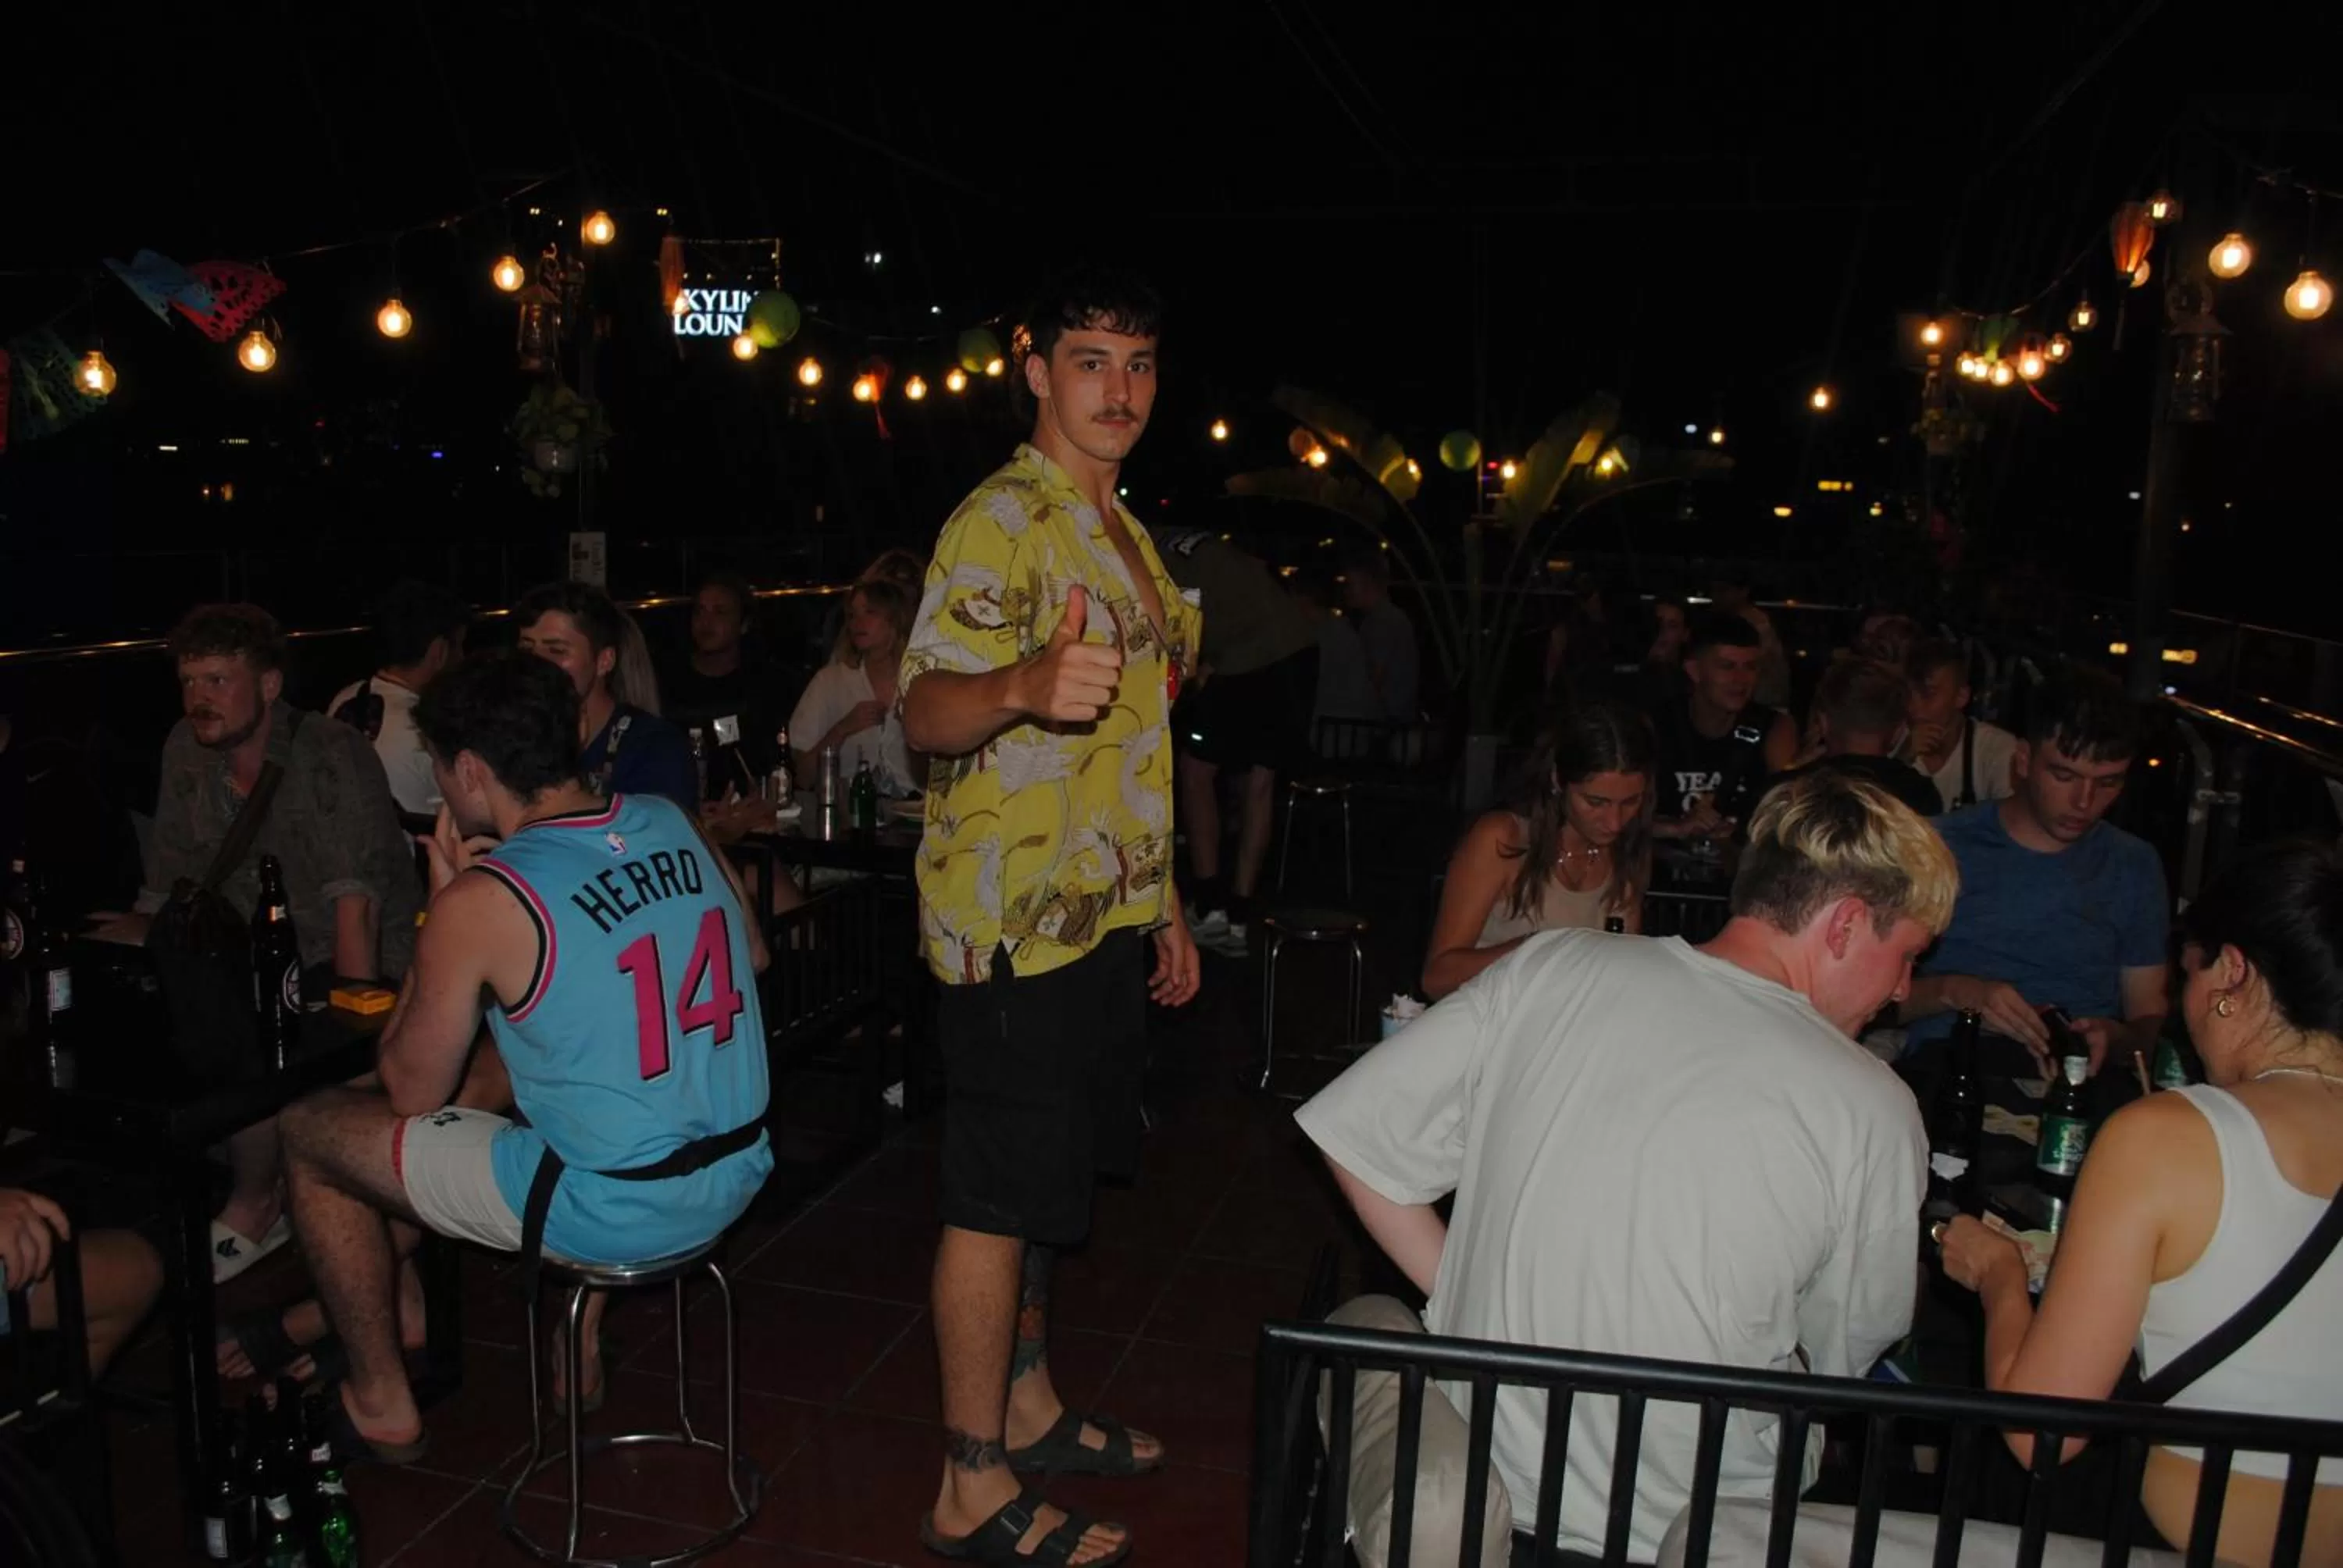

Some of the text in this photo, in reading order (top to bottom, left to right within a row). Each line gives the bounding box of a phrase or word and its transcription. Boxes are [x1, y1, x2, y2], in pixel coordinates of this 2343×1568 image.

[683, 288, 758, 312] KYLIN
[674, 313, 744, 336] LOUN
[1674, 771, 1723, 793] YEA
[570, 850, 702, 933] HERRO
[617, 907, 743, 1082] 14
